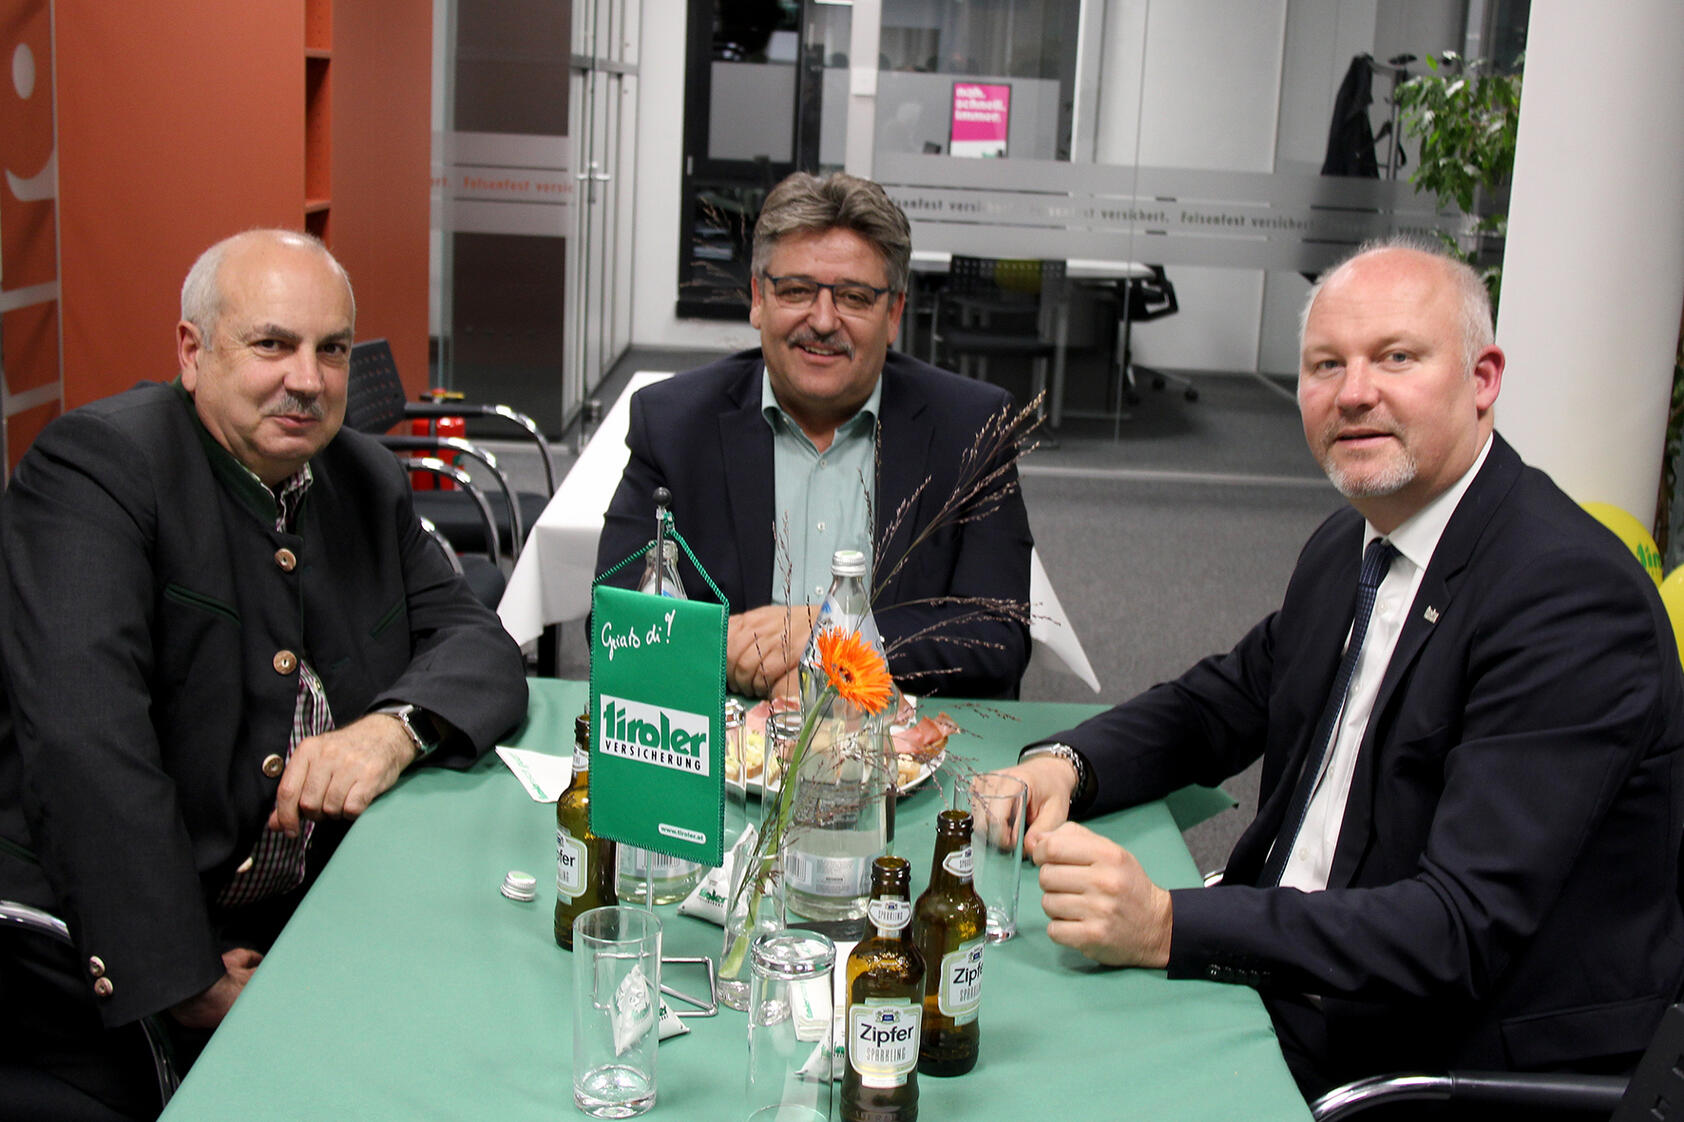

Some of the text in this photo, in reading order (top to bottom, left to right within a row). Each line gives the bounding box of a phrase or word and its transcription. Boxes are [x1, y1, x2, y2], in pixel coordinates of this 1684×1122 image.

[603, 700, 707, 758] tiroler
[605, 740, 701, 771] VERSICHERUNG
[660, 826, 704, 841] www.tiroler.at
[860, 1022, 915, 1049] Zipfer
[866, 1046, 906, 1063] SPARKLING
